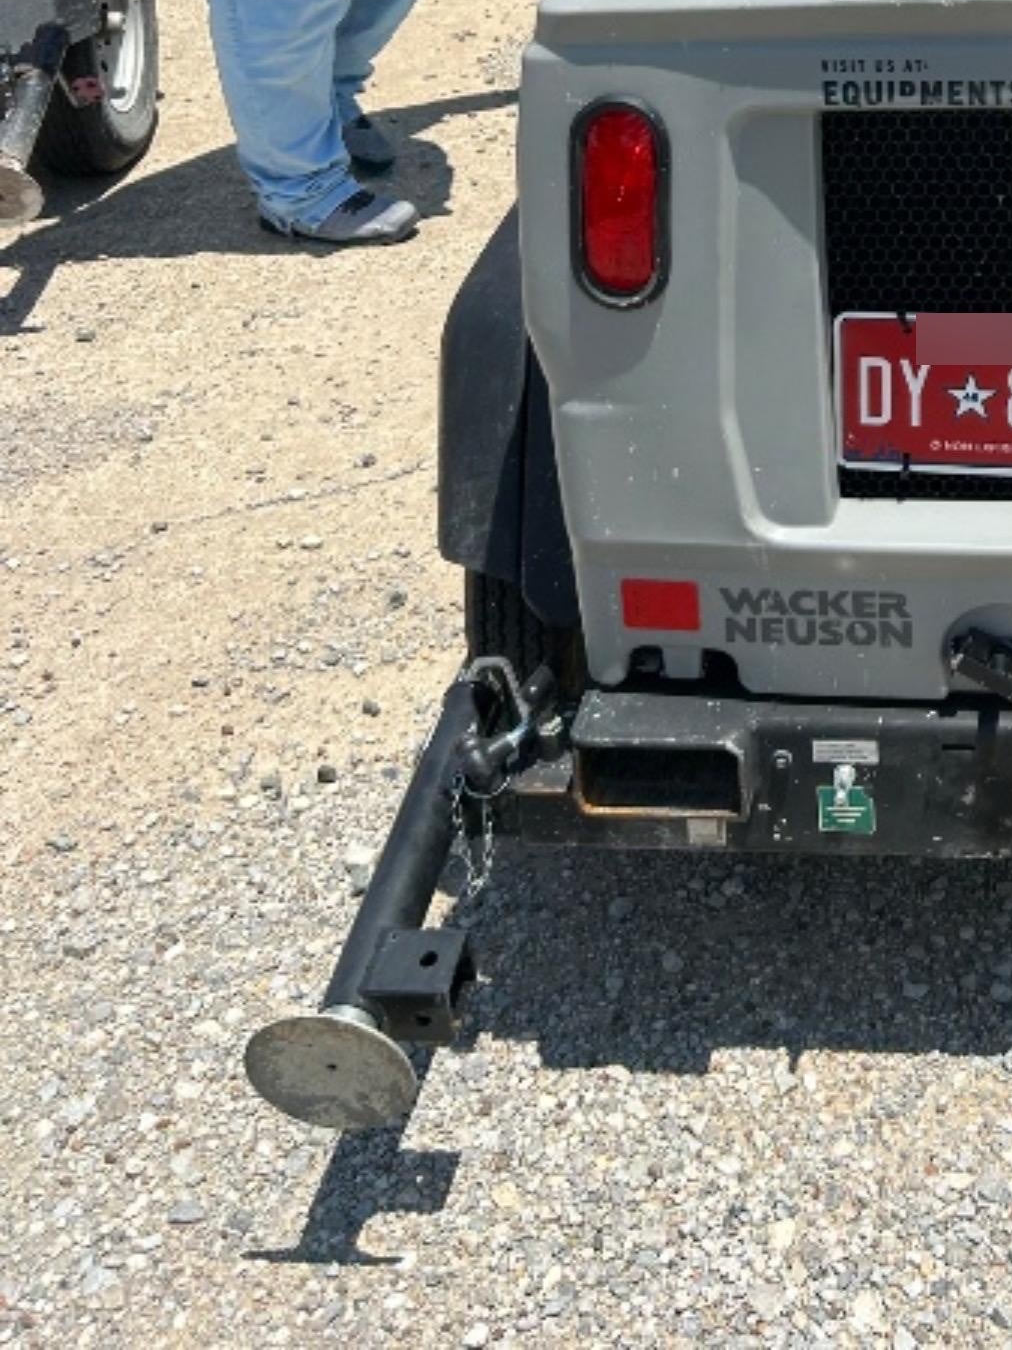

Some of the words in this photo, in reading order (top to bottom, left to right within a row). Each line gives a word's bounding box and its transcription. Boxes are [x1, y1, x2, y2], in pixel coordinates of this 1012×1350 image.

[821, 59, 865, 72] VISIT
[874, 59, 895, 72] US
[859, 356, 932, 428] DY
[720, 588, 912, 617] WACKER
[725, 618, 913, 647] NEUSON
